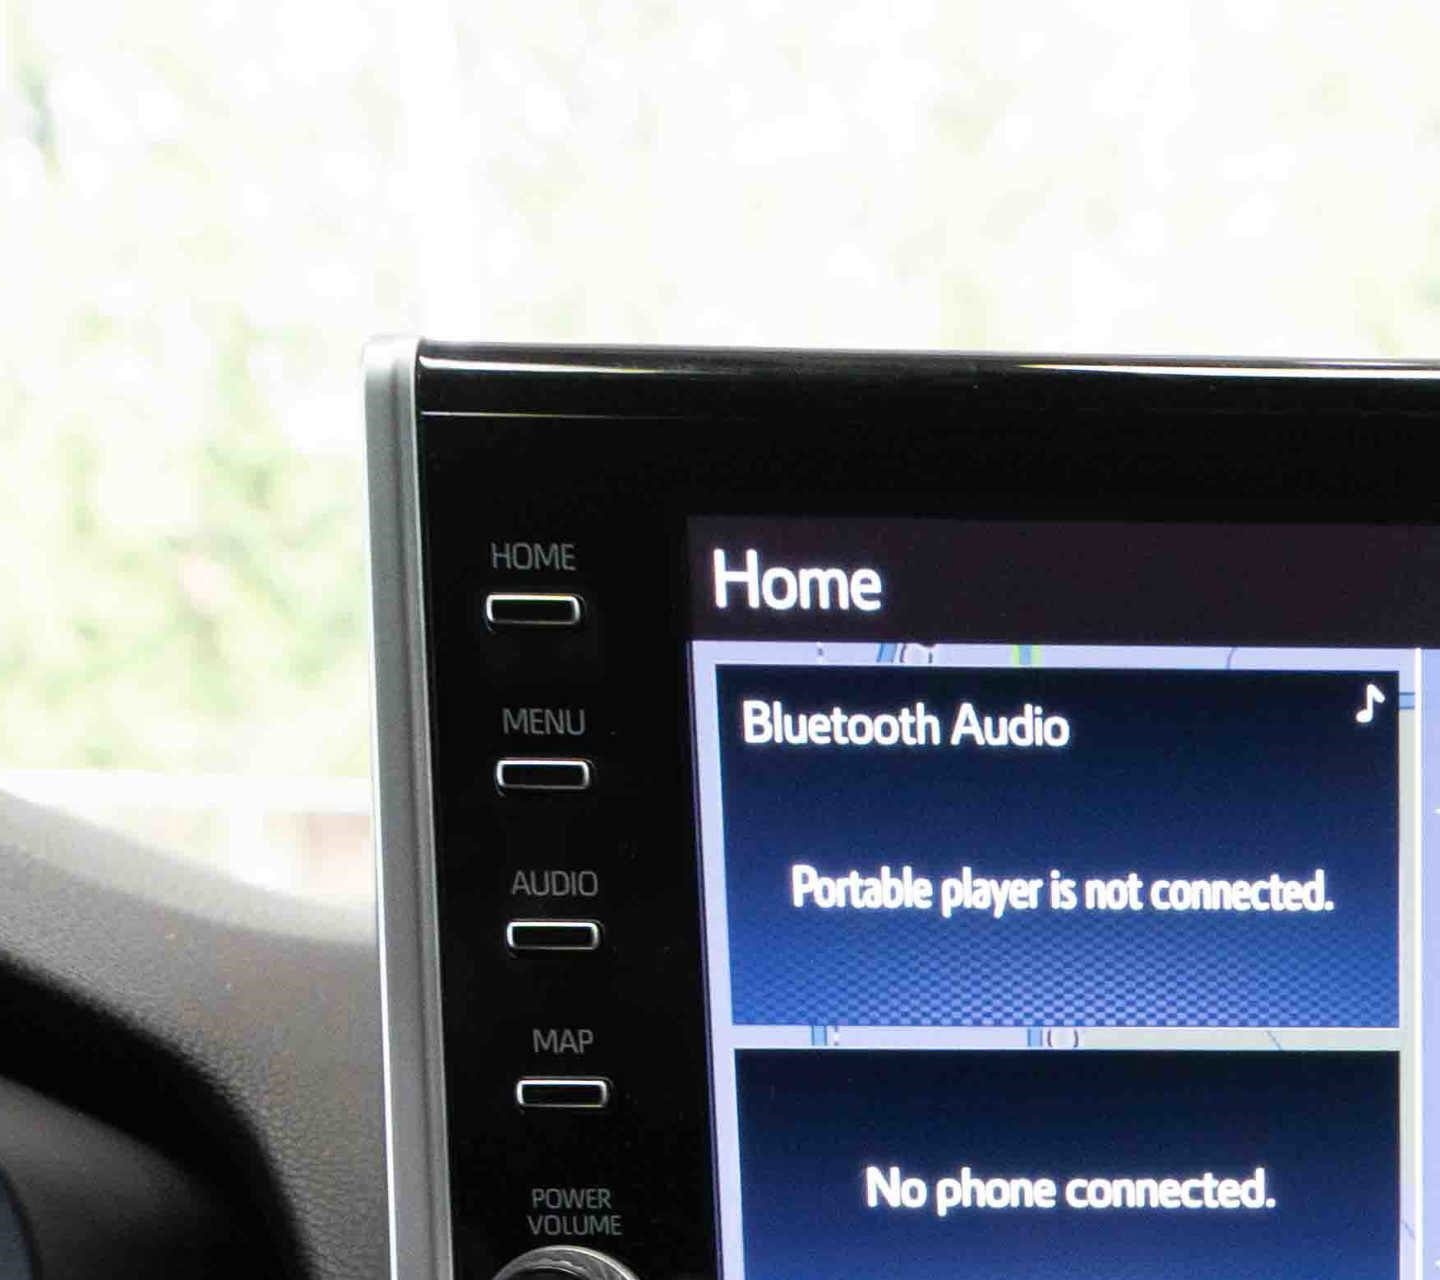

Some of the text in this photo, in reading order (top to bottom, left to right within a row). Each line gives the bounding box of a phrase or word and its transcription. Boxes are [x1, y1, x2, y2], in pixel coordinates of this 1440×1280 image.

[491, 542, 576, 571] HOME
[713, 548, 883, 612] Home
[503, 708, 586, 736] MENU
[742, 699, 1071, 748] Bluetooth Audio
[511, 870, 599, 897] AUDIO
[791, 863, 1335, 920] Portable player is not connected.
[532, 1028, 594, 1054] MAP
[531, 1187, 612, 1210] POWER
[865, 1165, 1277, 1217] No phone connected.
[527, 1214, 623, 1236] VOLUME
